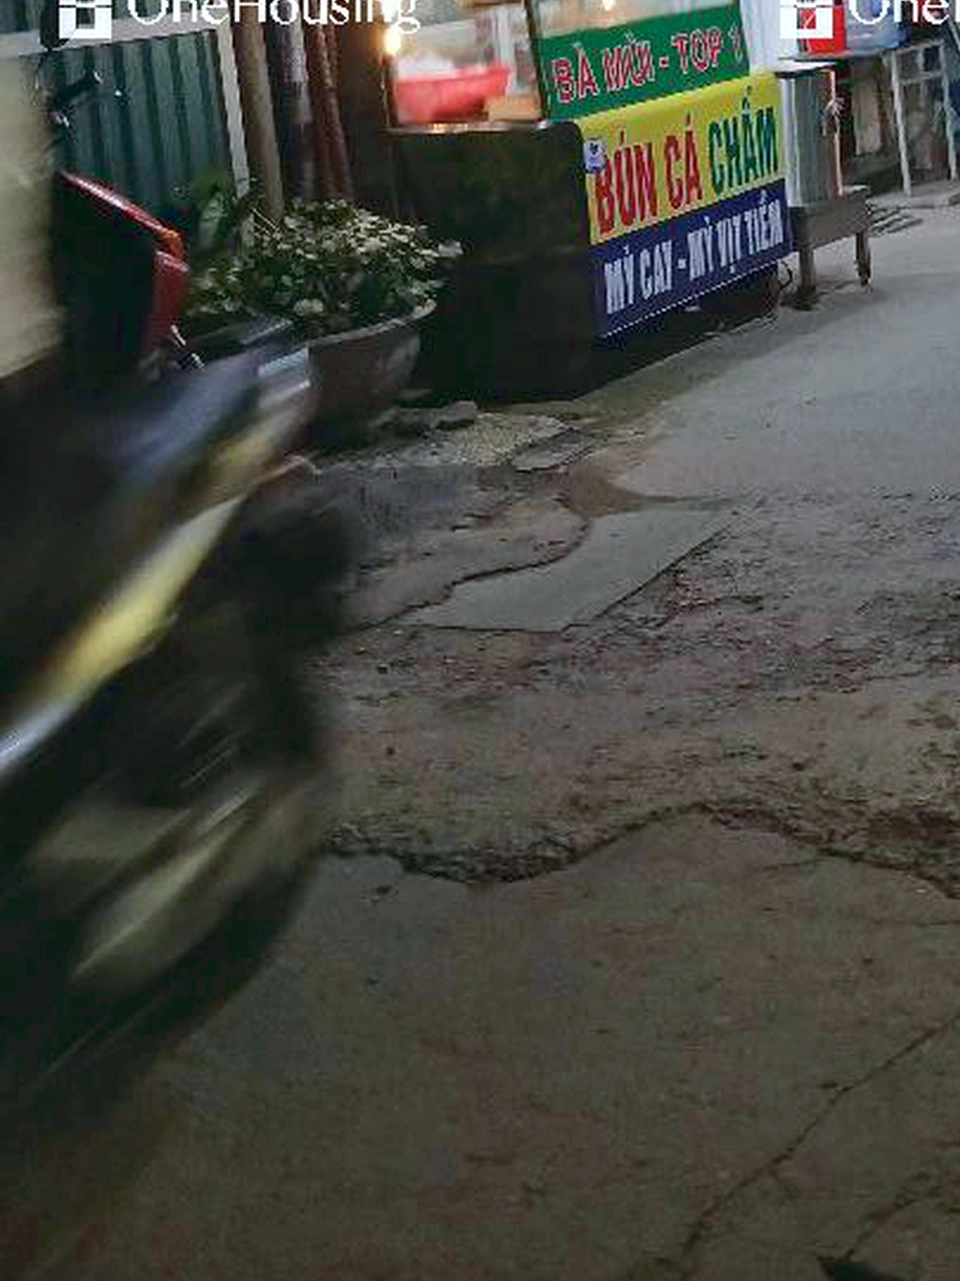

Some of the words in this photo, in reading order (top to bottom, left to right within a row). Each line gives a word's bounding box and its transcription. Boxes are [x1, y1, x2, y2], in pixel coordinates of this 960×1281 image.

[552, 40, 600, 104] BÀ
[671, 26, 722, 75] TOP
[595, 130, 658, 236] BÚN
[664, 111, 703, 210] CÁ
[709, 86, 778, 200] CHẤM
[640, 239, 673, 301] CAY
[717, 214, 742, 274] VỊT
